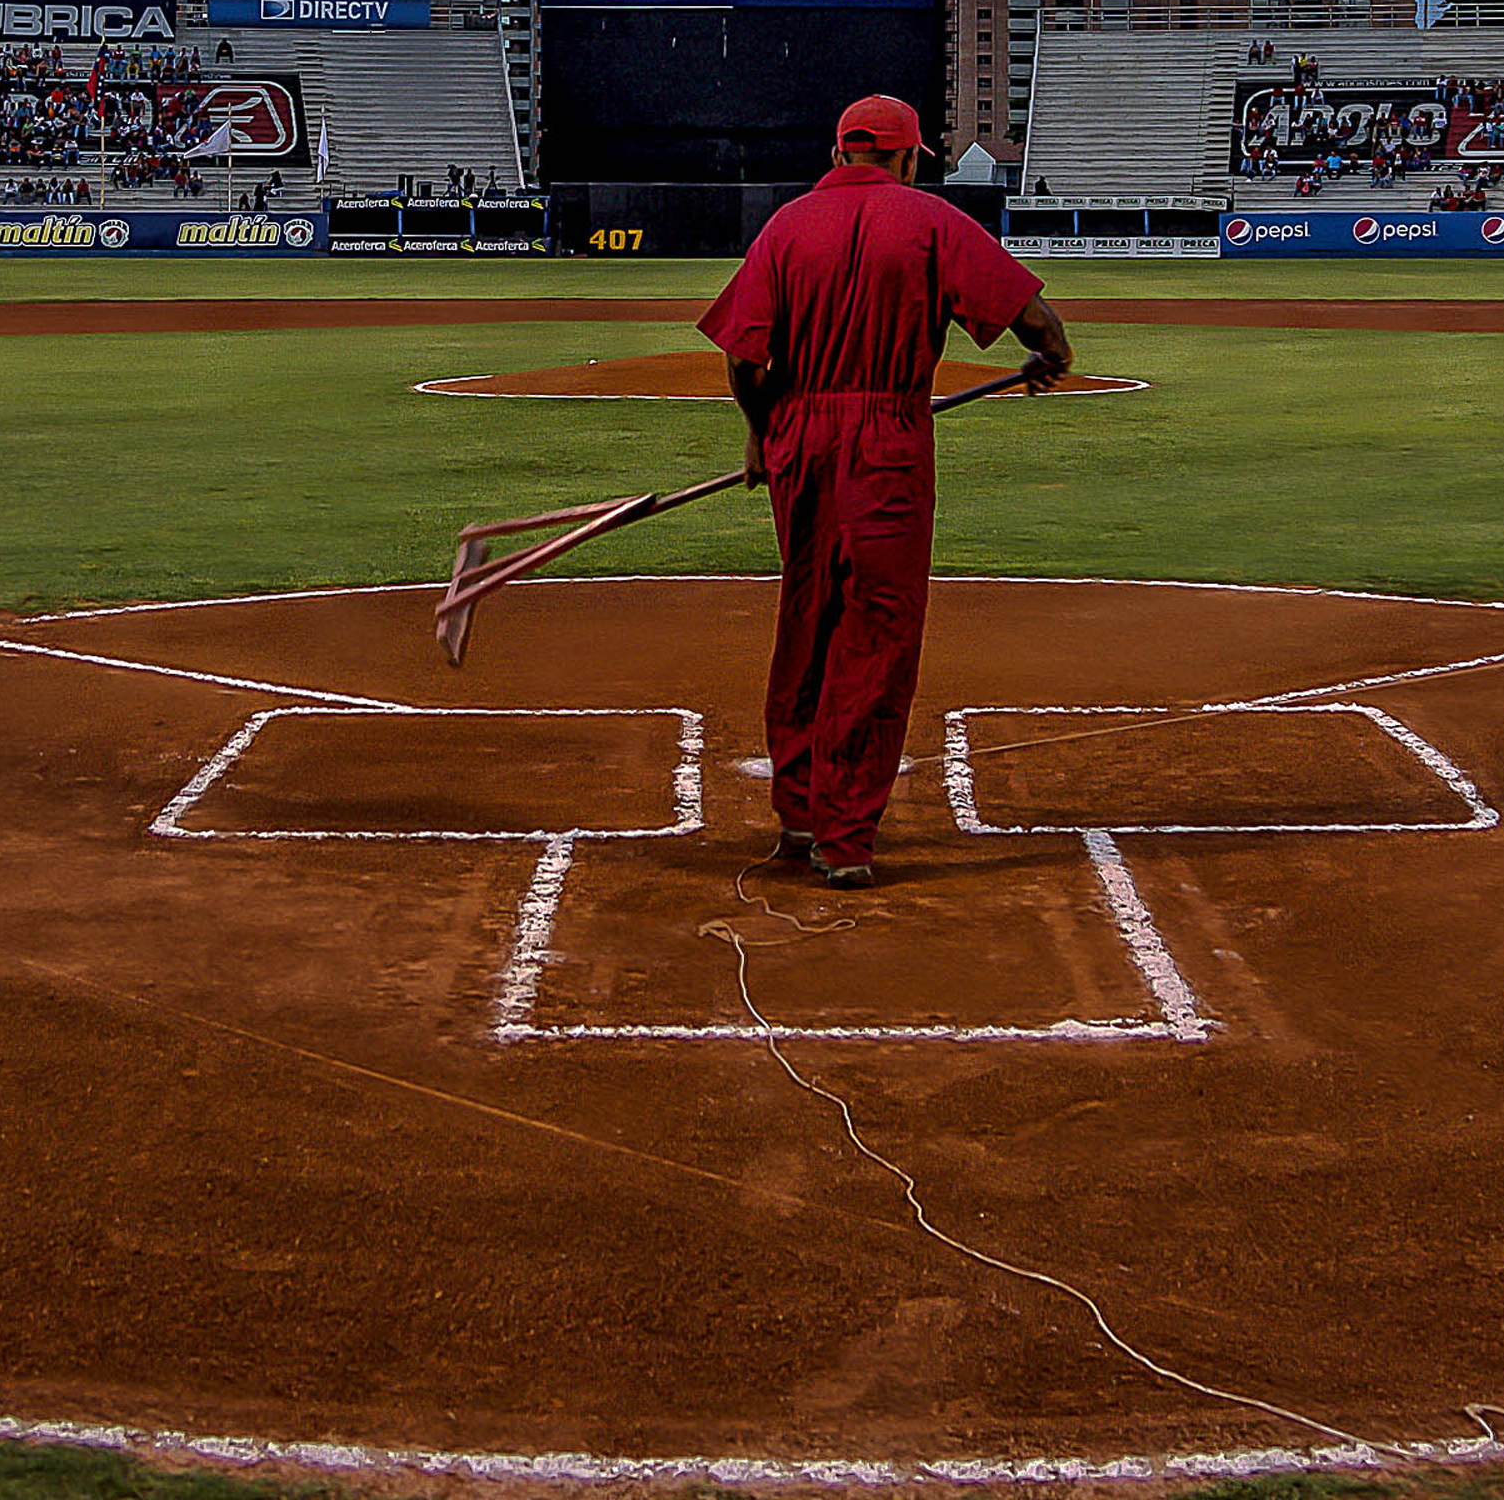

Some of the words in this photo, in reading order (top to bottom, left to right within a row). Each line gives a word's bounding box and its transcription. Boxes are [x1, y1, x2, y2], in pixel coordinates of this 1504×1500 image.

[299, 1, 388, 20] DIRECTV
[336, 198, 389, 209] Aceroferca
[407, 197, 459, 208] Aceroferca
[477, 198, 530, 209] Aceroferca
[177, 215, 280, 245] maltín
[1256, 221, 1309, 241] pepsi
[1384, 221, 1437, 241] pepsi
[331, 240, 386, 251] Aceroferca
[403, 240, 458, 251] Aceroferca
[475, 240, 529, 251] Aceroferca
[589, 230, 643, 250] 407
[1006, 239, 1040, 247] PRECA
[1051, 239, 1084, 247] PRECA
[1095, 239, 1128, 247] PRECA
[1139, 239, 1172, 247] PRECA
[1183, 239, 1216, 247] PRECA
